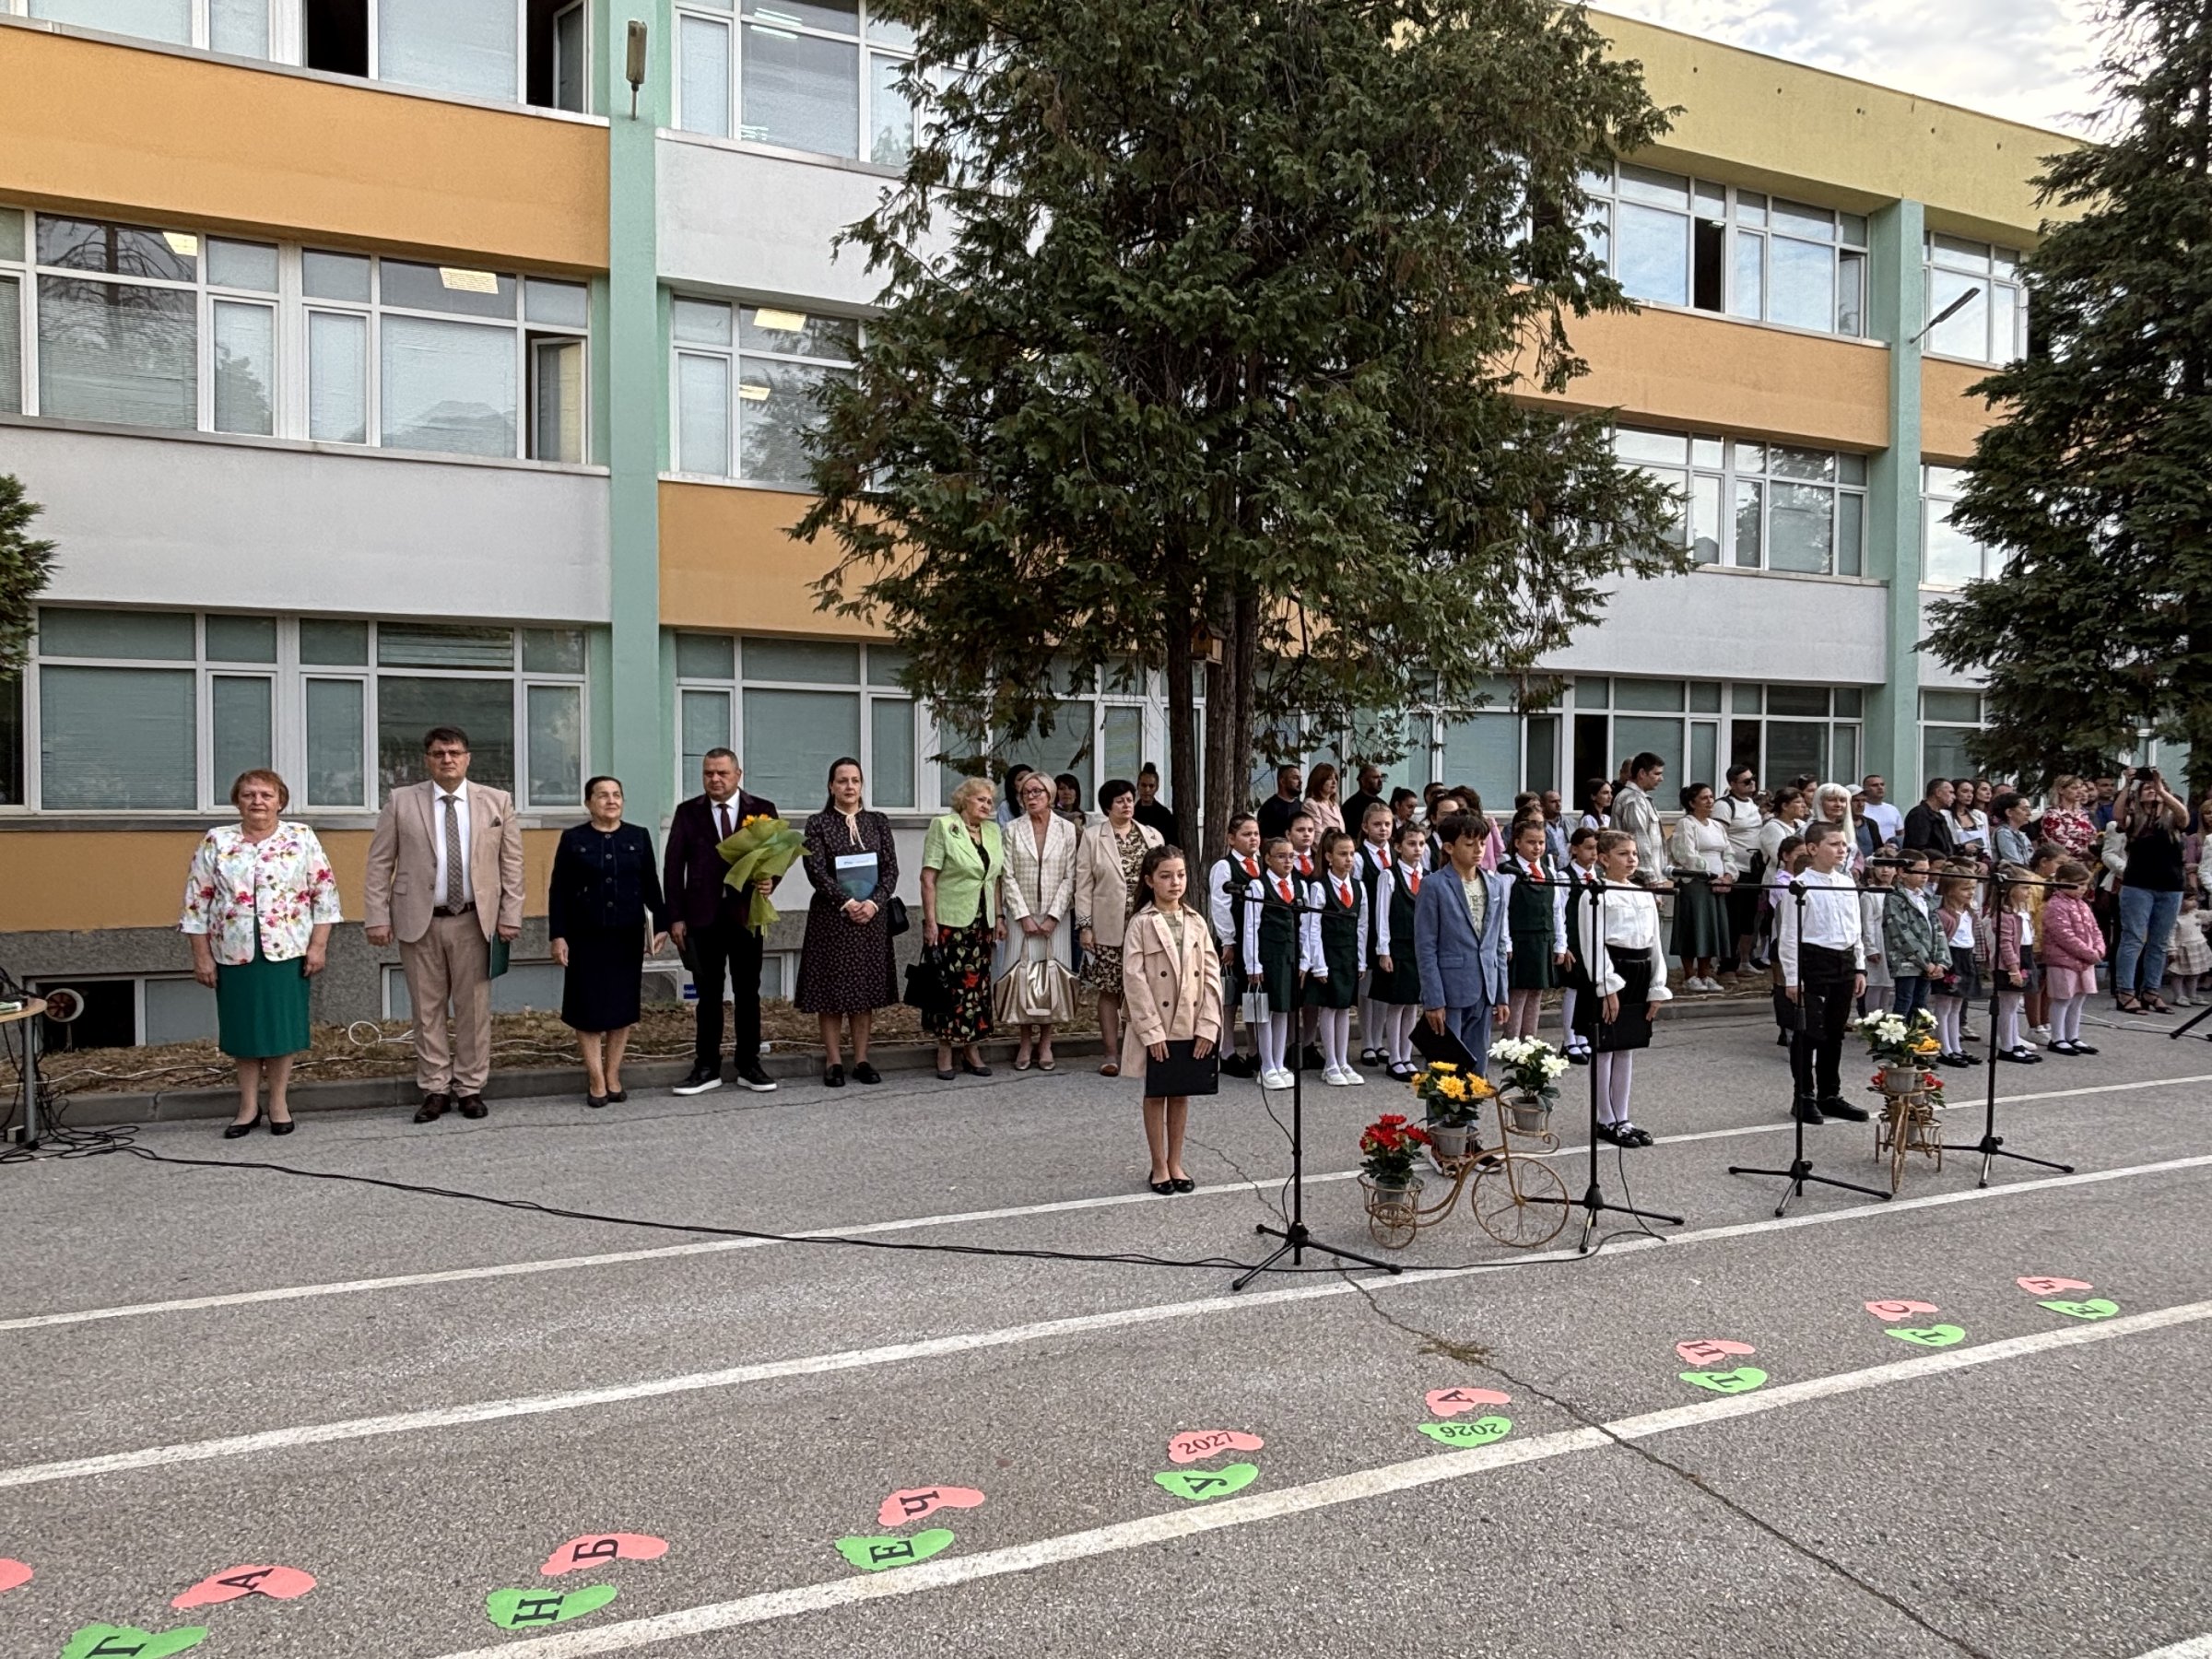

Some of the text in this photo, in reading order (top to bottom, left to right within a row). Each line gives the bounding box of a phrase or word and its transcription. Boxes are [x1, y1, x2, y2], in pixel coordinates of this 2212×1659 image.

[1876, 1302, 1910, 1313] С
[1910, 1331, 1947, 1343] Т
[1706, 1375, 1745, 1388] Т
[1438, 1390, 1475, 1403] А
[1440, 1423, 1503, 1438] 2026
[1178, 1431, 1233, 1454] 2027
[572, 1538, 618, 1562] Б
[869, 1540, 914, 1563] Е
[217, 1568, 274, 1590] А
[512, 1595, 564, 1625] Н
